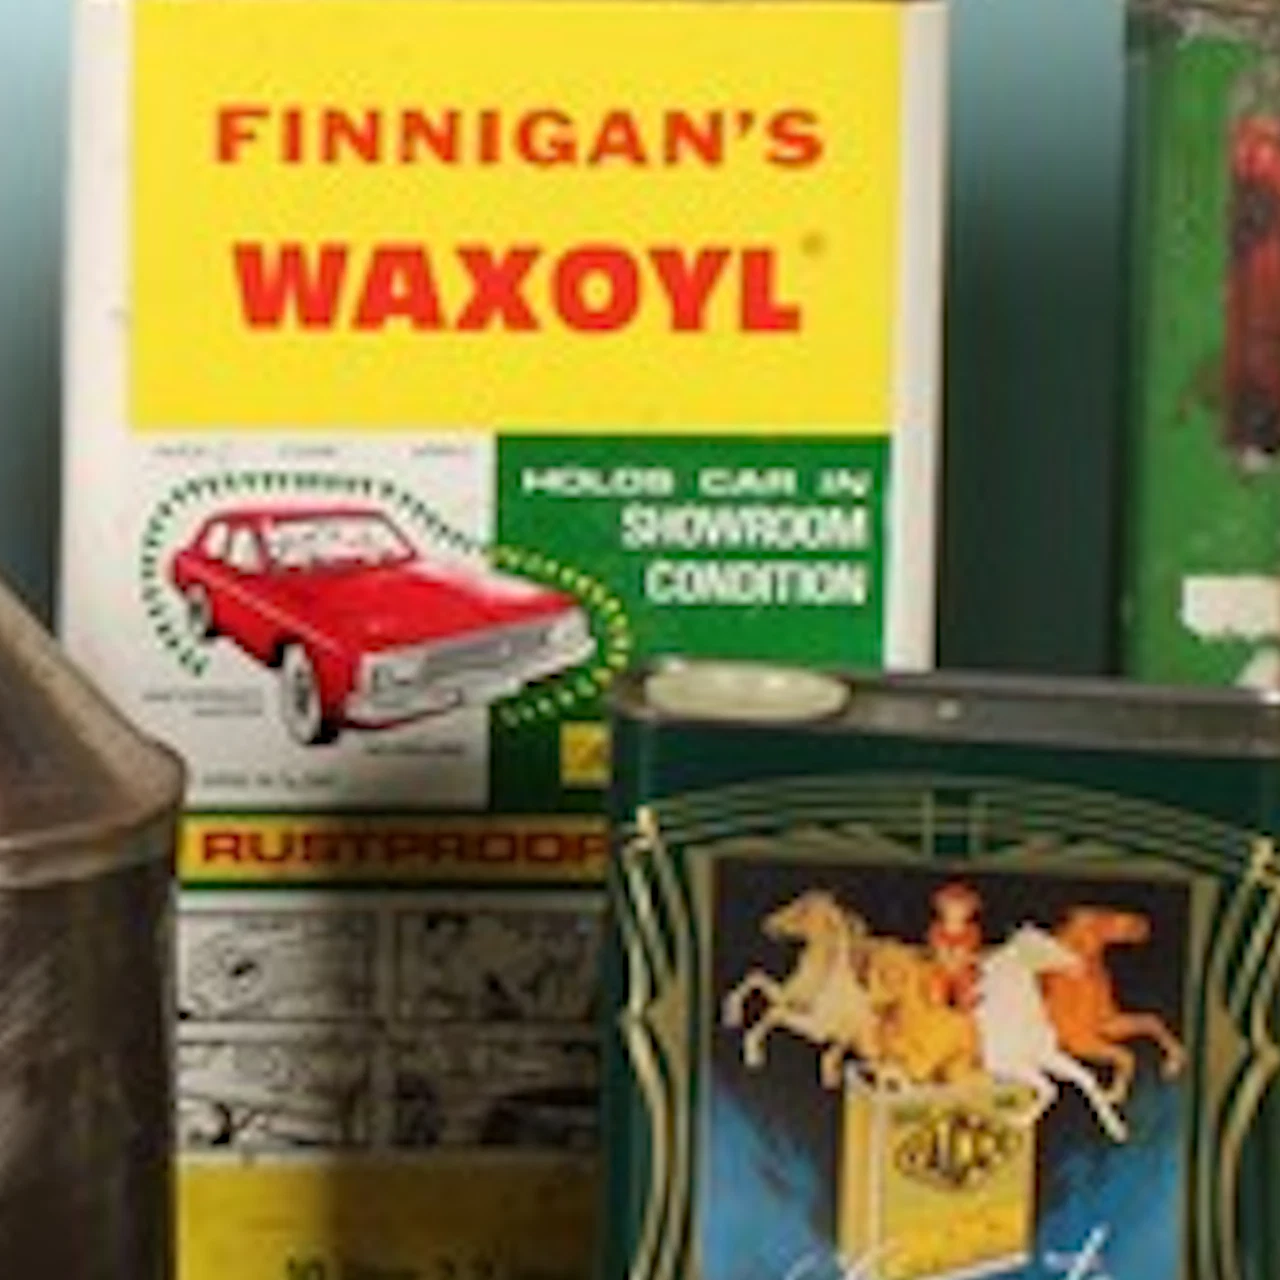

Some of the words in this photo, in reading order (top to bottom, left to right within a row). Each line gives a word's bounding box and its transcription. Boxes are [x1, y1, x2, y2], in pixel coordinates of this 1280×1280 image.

[215, 106, 825, 167] FINNIGAN'S
[233, 243, 801, 333] WAXOYL
[521, 466, 676, 498] HOLDS
[698, 466, 798, 498] CAR
[818, 467, 874, 498] IN
[620, 505, 868, 552] SHOWROOM
[645, 561, 866, 607] CONDITION
